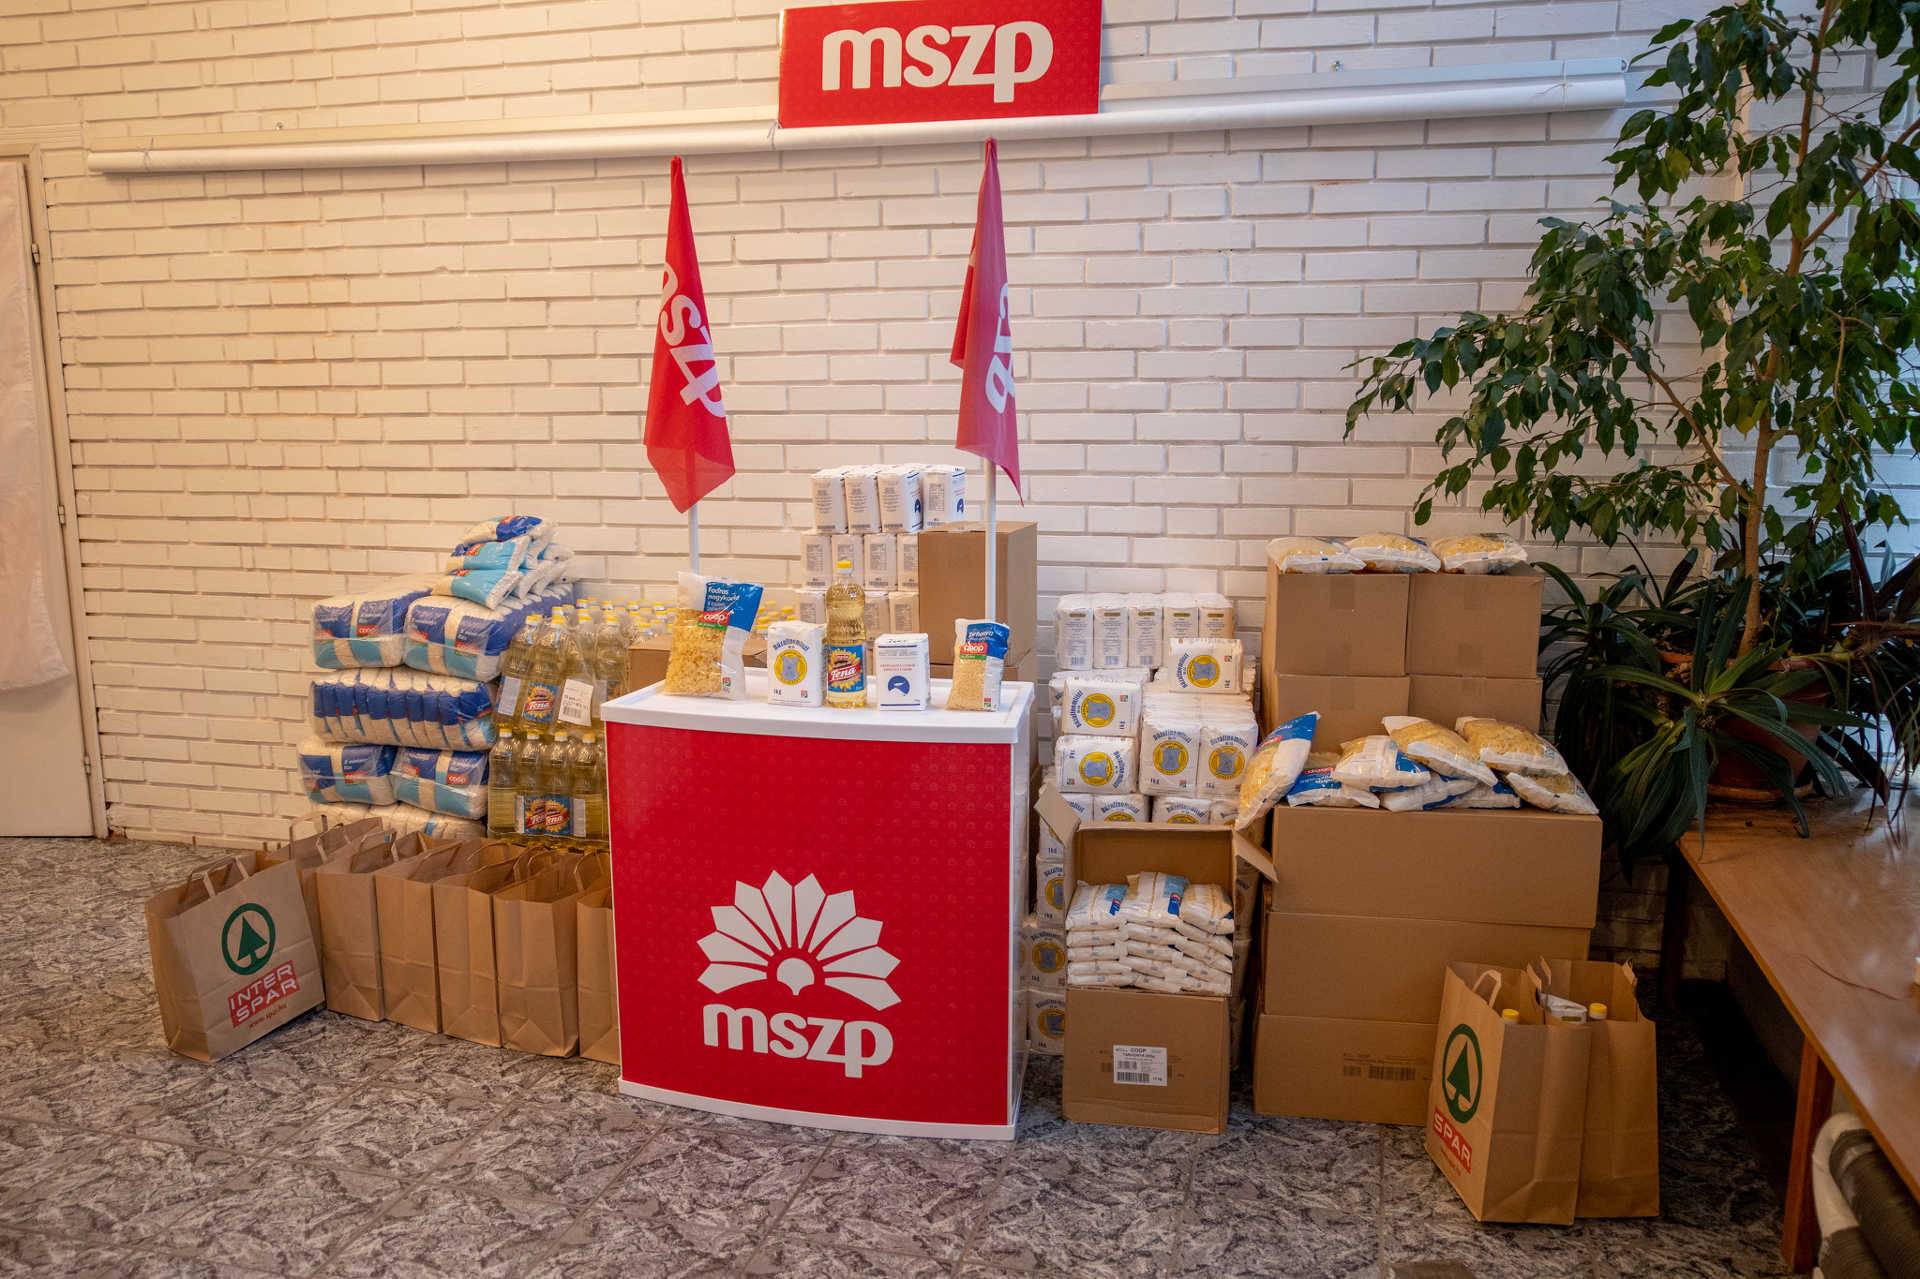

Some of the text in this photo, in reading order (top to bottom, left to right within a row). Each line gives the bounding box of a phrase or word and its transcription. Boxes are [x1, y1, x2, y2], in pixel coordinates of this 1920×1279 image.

[822, 20, 1054, 103] mszp
[830, 666, 857, 680] Tena
[230, 964, 293, 1010] INTER
[236, 978, 297, 1022] SPAR
[703, 1003, 894, 1078] mszp
[1433, 1112, 1472, 1168] SPAR
